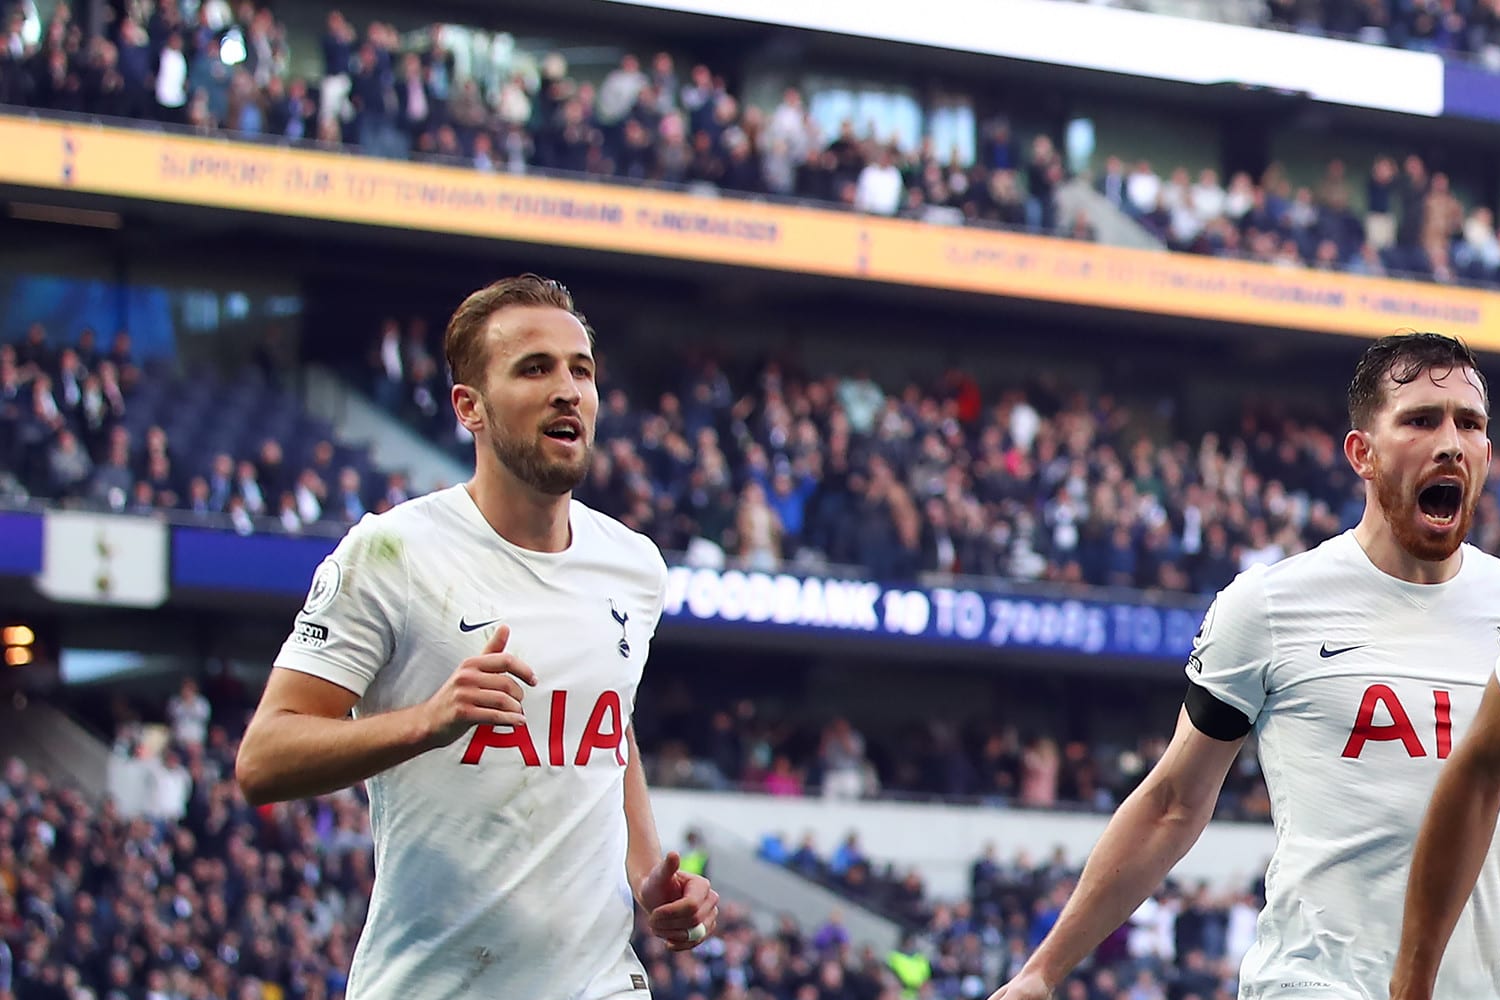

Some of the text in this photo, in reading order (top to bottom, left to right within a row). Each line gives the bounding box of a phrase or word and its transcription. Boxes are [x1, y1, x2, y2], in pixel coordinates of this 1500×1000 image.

[884, 589, 930, 636] 10
[933, 588, 985, 639] TO
[461, 690, 627, 766] AIA
[1341, 684, 1453, 759] AI
